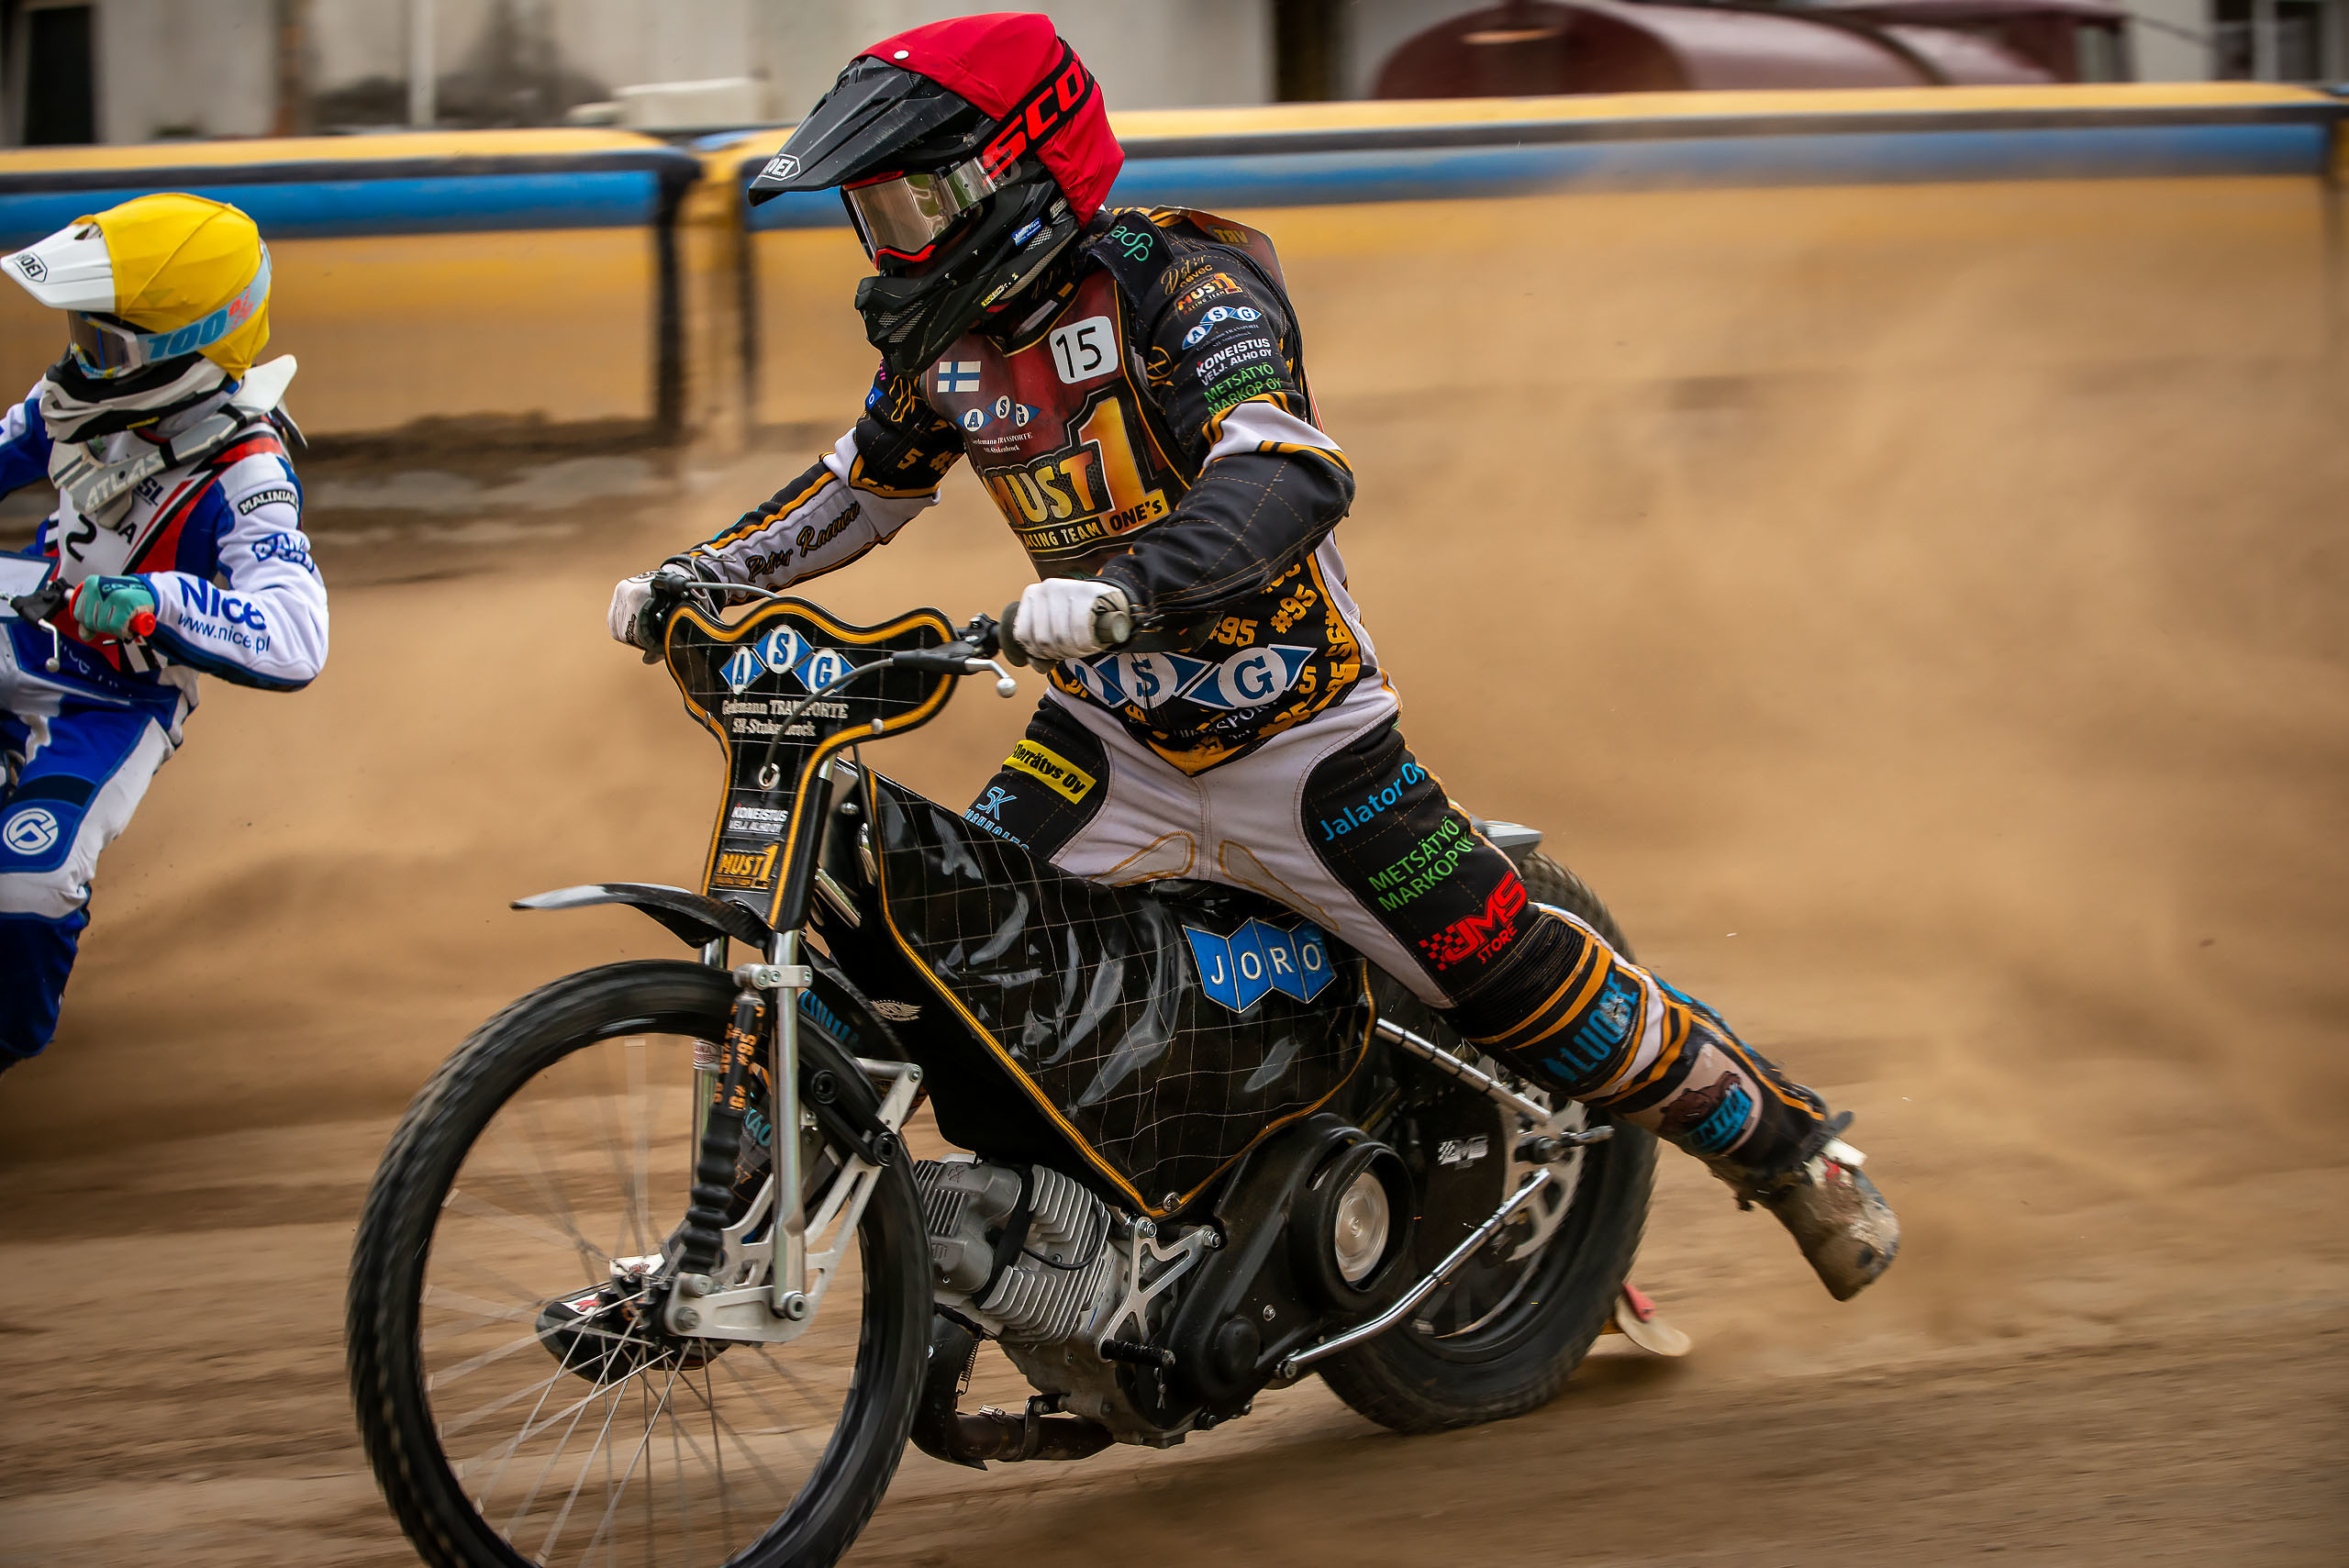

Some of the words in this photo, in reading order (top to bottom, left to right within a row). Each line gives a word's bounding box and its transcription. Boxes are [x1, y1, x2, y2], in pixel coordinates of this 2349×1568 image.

[981, 59, 1092, 183] SCO
[148, 286, 255, 359] 100%
[1055, 326, 1102, 378] 15
[1197, 338, 1272, 377] KONEISTUS
[1201, 362, 1229, 386] VELJ.
[1230, 350, 1259, 366] ALHO
[1259, 349, 1272, 357] OY
[1204, 361, 1275, 403] METSÄTYÖ
[1208, 381, 1264, 417] MARKOP
[1265, 377, 1282, 390] OY
[1061, 521, 1103, 544] TEAM
[1271, 583, 1318, 634] #95
[178, 613, 271, 654] www.nice.pl
[1062, 773, 1086, 795] Oy
[1319, 778, 1403, 841] Jalator
[1368, 816, 1460, 892] METSÄTYÖ
[1378, 850, 1459, 911] MARKOP
[1475, 920, 1519, 963] STORE
[1210, 942, 1322, 985] JORO
